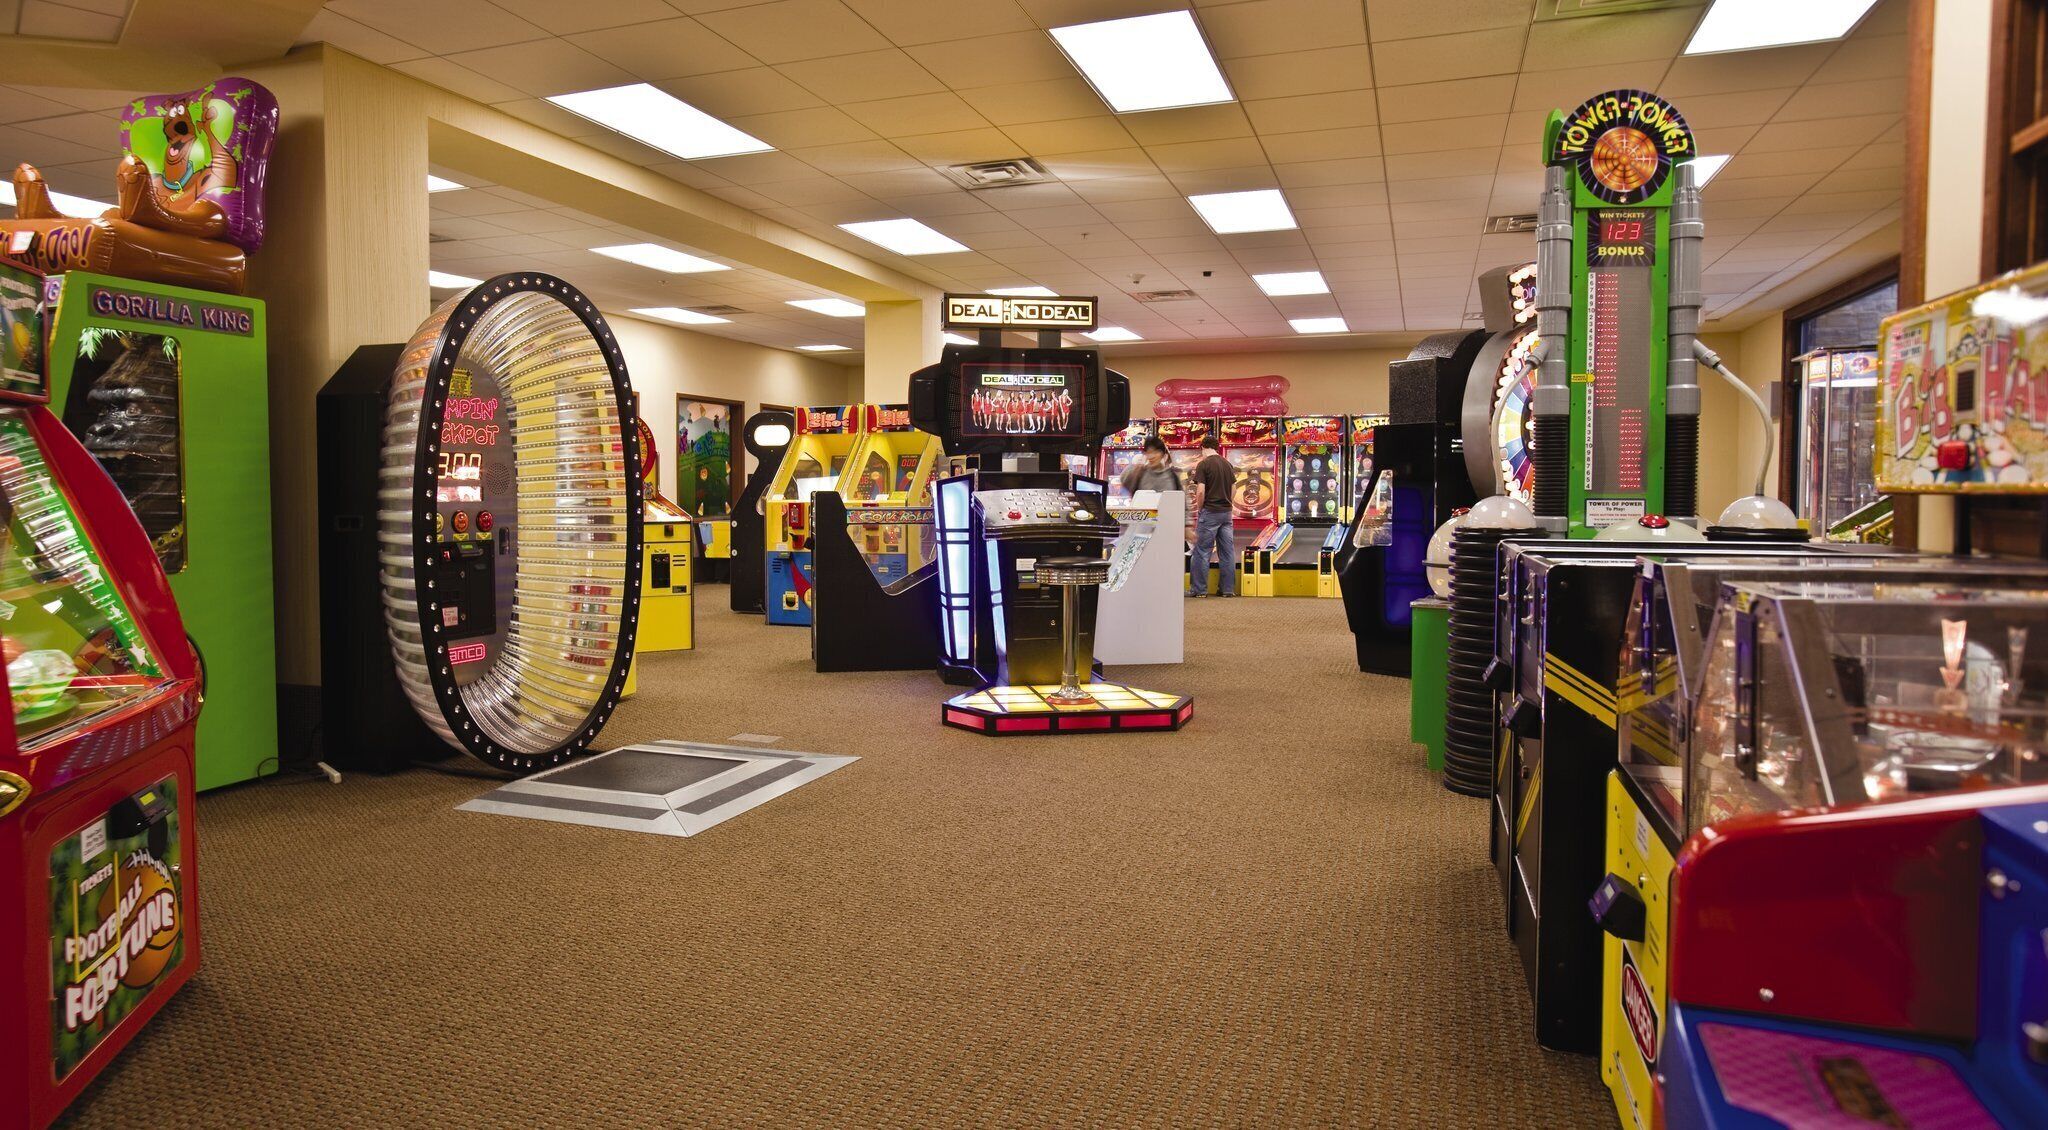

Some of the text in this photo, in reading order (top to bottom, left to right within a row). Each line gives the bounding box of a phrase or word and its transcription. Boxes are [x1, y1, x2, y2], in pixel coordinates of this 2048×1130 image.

[1562, 97, 1621, 155] TOWER
[1628, 97, 1688, 154] POWER
[1608, 223, 1640, 240] 123
[1598, 246, 1645, 256] BONUS
[94, 288, 194, 325] GORILLA
[201, 308, 251, 332] KING
[951, 304, 998, 317] DEAL
[1014, 304, 1039, 319] NO
[1041, 305, 1089, 320] DEAL
[1020, 376, 1035, 384] NO
[1036, 376, 1063, 384] DEAL
[444, 397, 498, 420] MPIN'
[441, 422, 499, 446] CKPOT
[809, 417, 849, 428] Shot
[449, 645, 484, 662] amco
[66, 875, 143, 963] FOOTBALL
[66, 889, 175, 1032] FORTUNE
[1626, 968, 1652, 1058] DANGER
